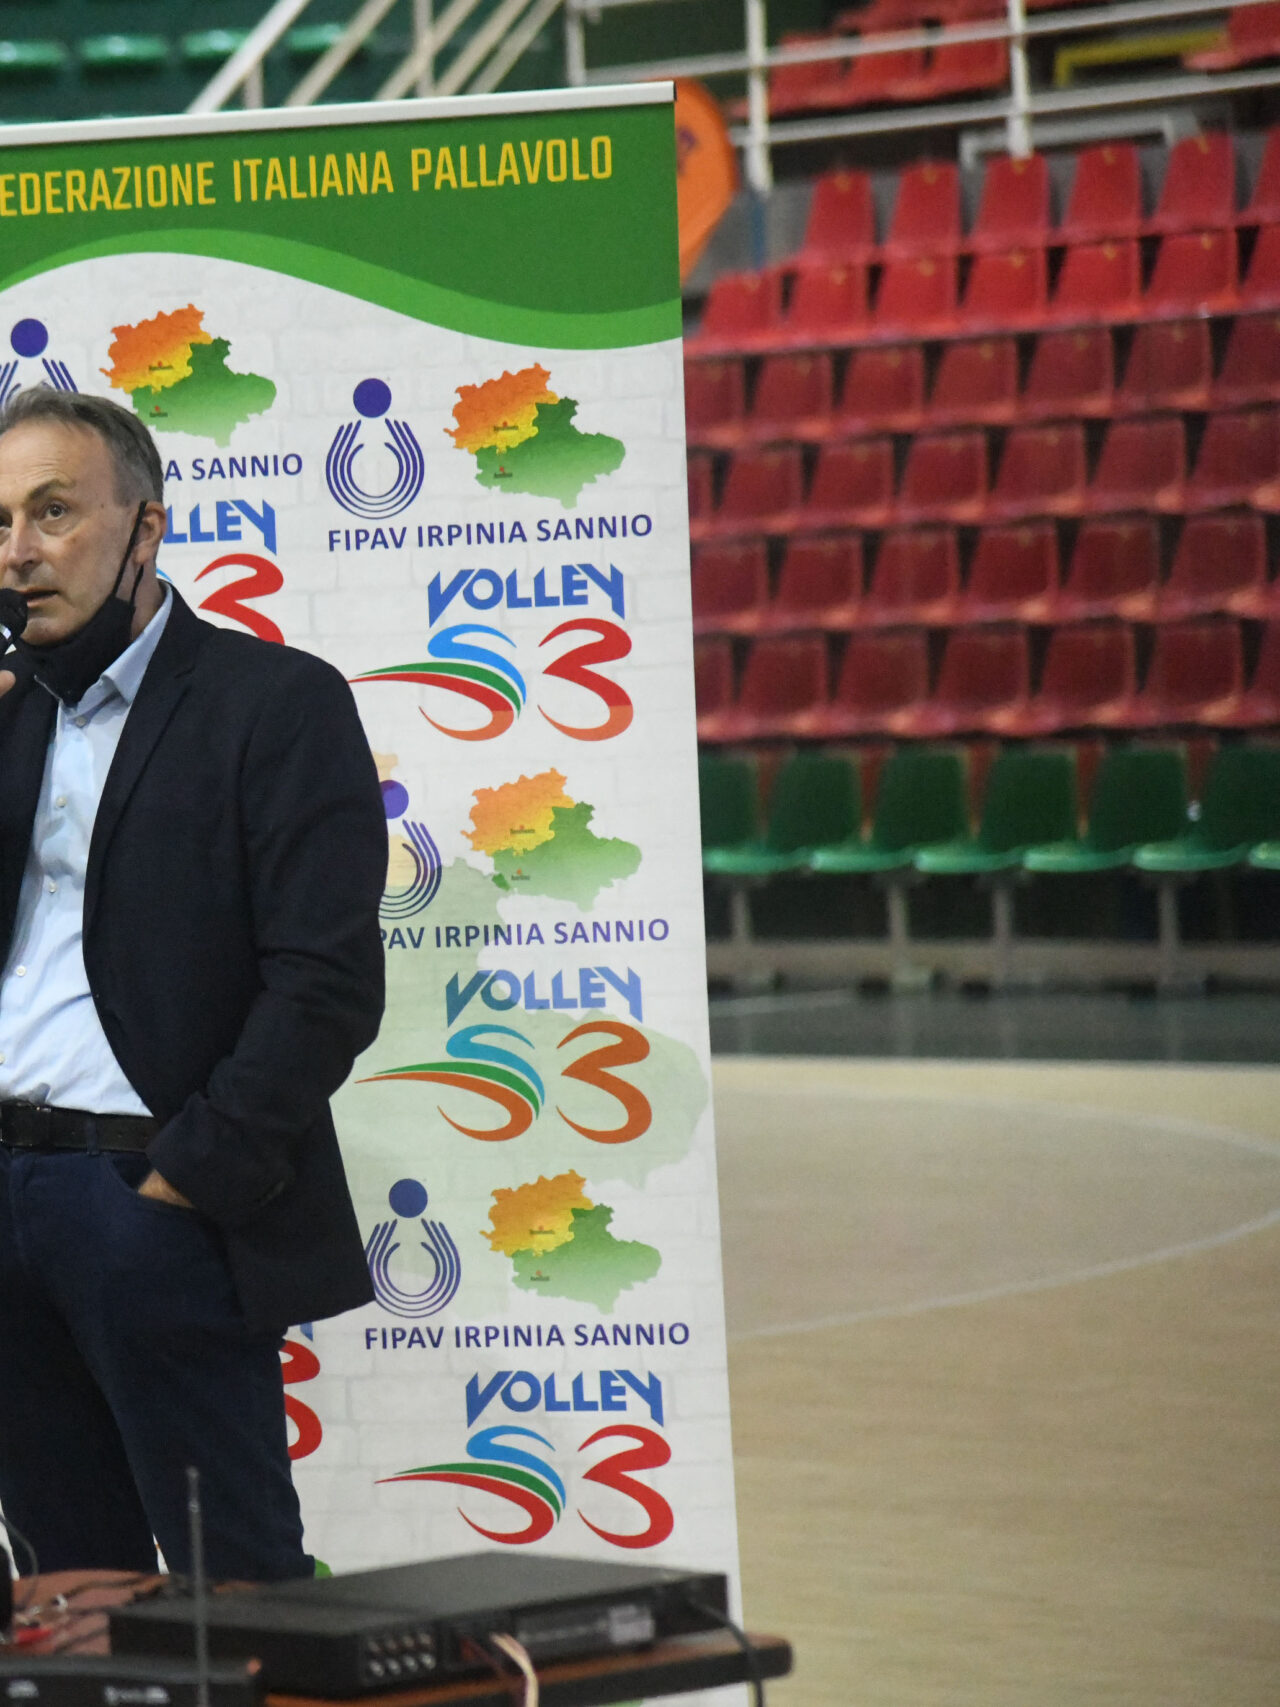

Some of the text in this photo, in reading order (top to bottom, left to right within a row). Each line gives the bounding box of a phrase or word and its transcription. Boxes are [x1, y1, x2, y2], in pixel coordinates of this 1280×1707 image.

[233, 151, 394, 202] ITALIANA
[411, 135, 612, 191] PALLAVOLO
[191, 453, 304, 481] SANNIO
[163, 499, 278, 557] LLEY
[327, 514, 653, 553] FIPAV IRPINIA SANNIO
[427, 563, 626, 629] VOLLEY
[434, 922, 545, 949] IRPINIA
[554, 918, 670, 944] SANNIO
[444, 966, 643, 1029] VOLLEY
[365, 1323, 691, 1350] FIPAV IRPINIA SANNIO
[465, 1369, 665, 1428] VOLLEY
